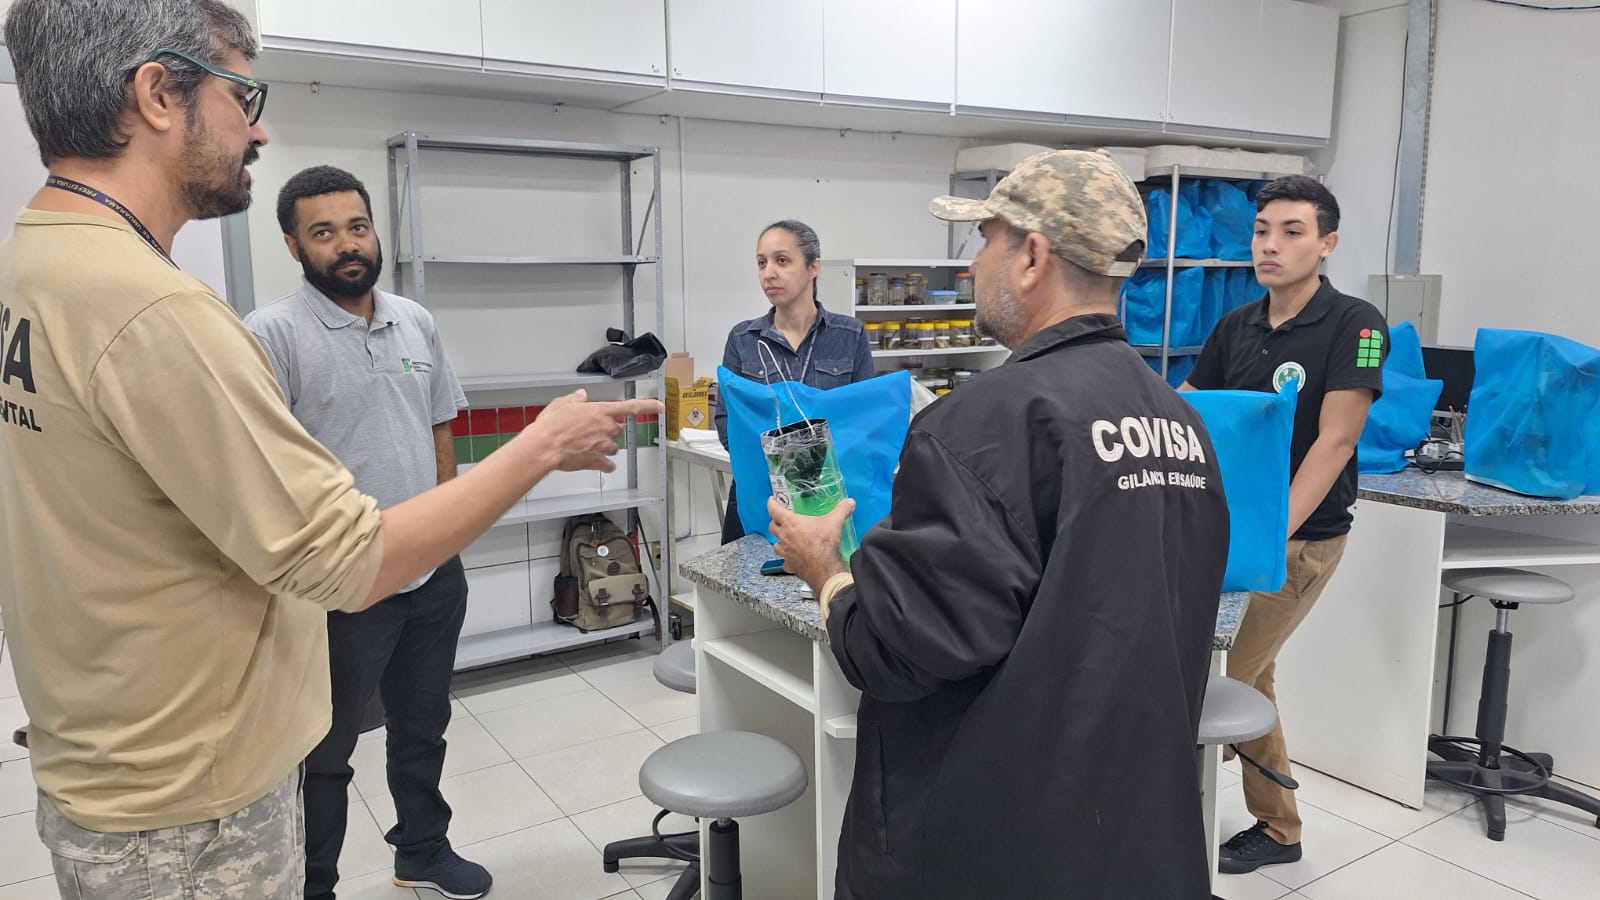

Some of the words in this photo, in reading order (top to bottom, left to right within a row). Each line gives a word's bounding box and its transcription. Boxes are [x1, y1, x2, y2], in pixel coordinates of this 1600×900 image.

[56, 180, 98, 197] PREFEITURA
[104, 197, 142, 230] UMUARAMA
[0, 303, 37, 394] SA
[1091, 416, 1206, 464] COVISA
